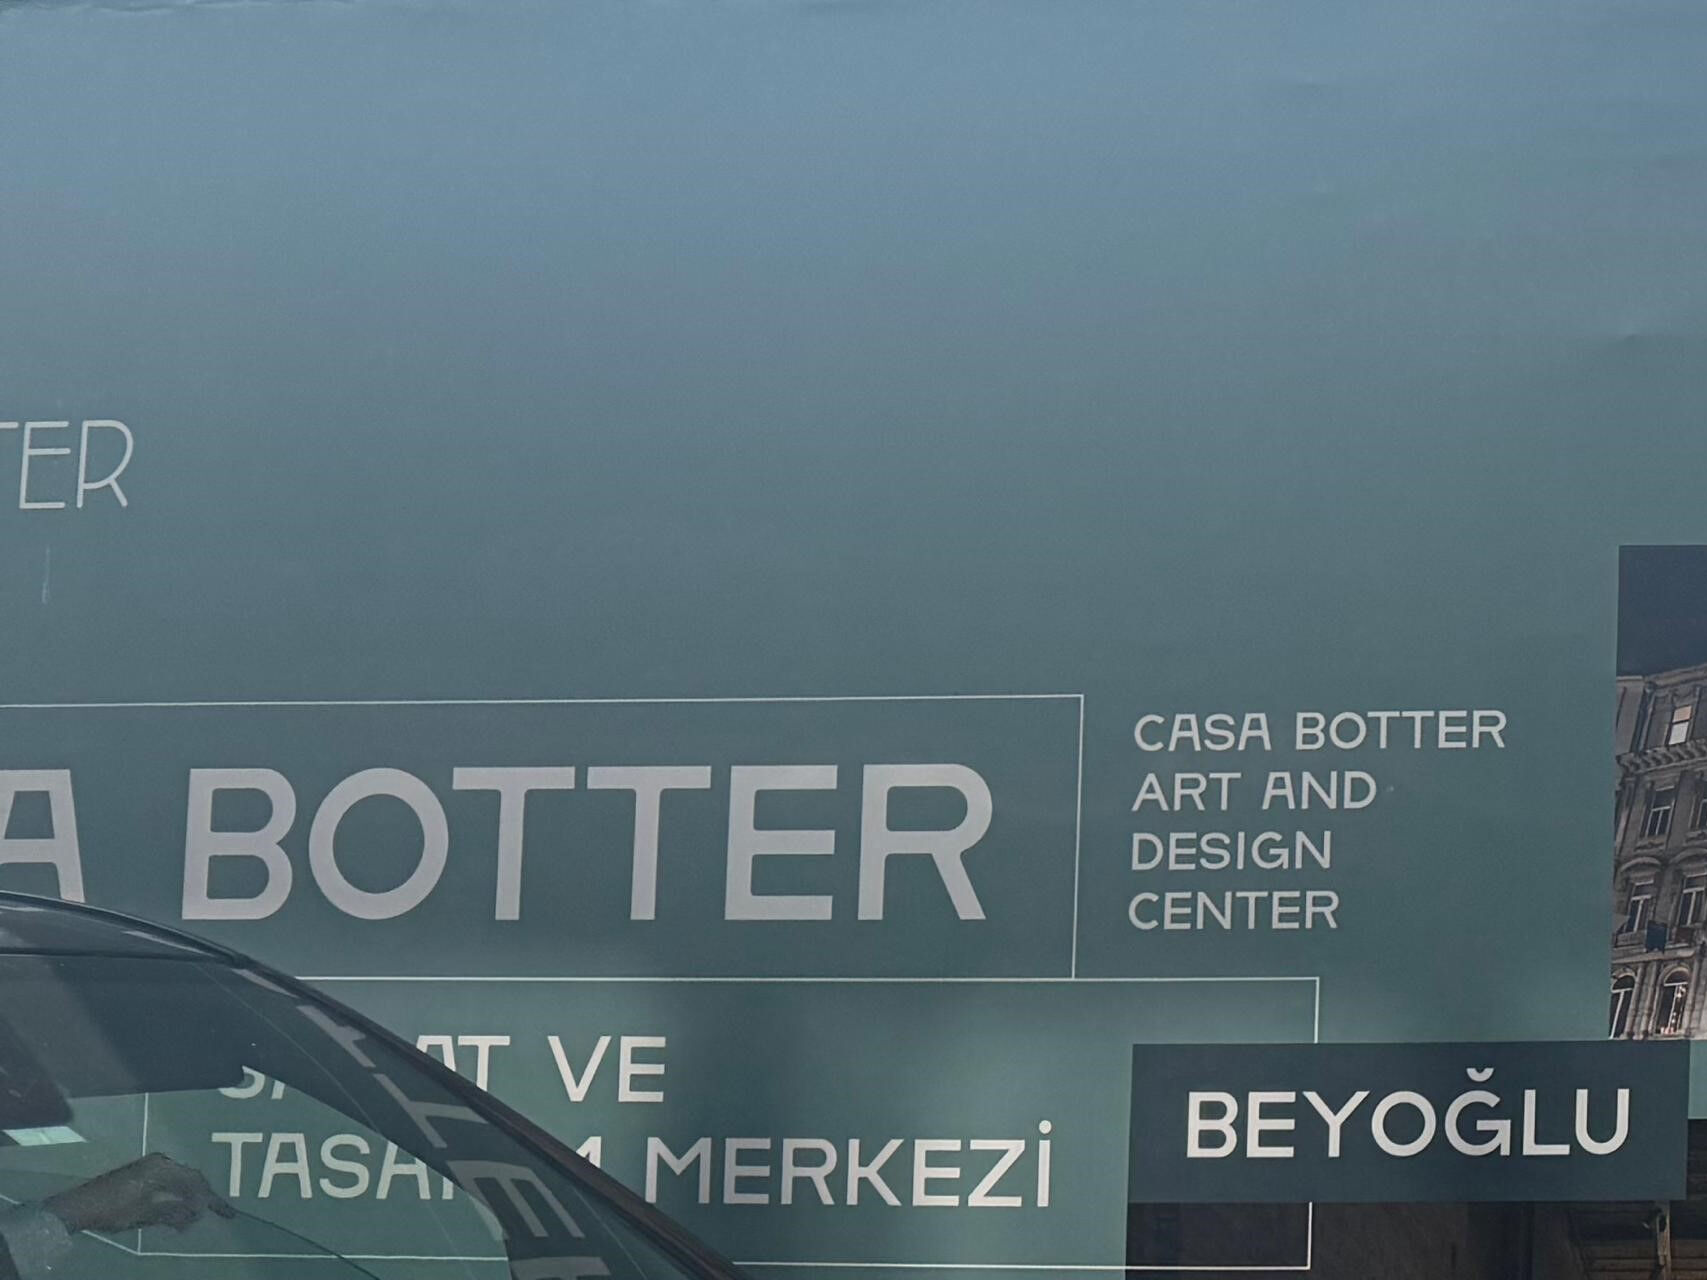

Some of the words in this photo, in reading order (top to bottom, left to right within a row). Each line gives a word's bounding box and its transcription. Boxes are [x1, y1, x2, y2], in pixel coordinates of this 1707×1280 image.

[1133, 713, 1271, 752] CASA
[1294, 709, 1509, 750] BOTTER
[1131, 772, 1241, 812] ART
[1260, 768, 1378, 810] AND
[182, 763, 994, 921] BOTTER
[1130, 831, 1333, 872] DESIGN
[1128, 889, 1340, 931] CENTER
[547, 1034, 667, 1103] VE
[1186, 1067, 1632, 1160] BEYOĞLU
[644, 1121, 1051, 1208] MERKEZİ
